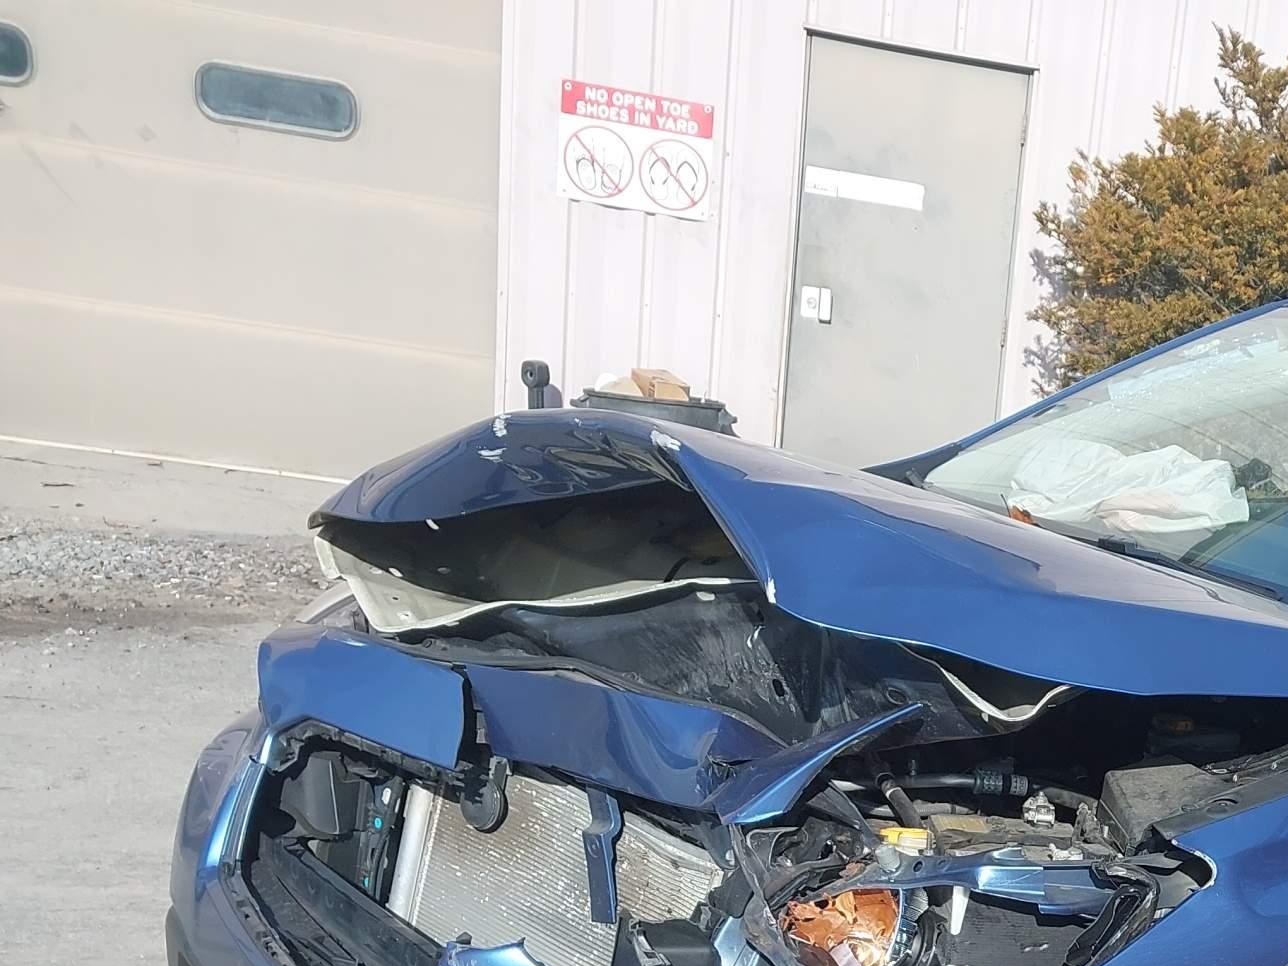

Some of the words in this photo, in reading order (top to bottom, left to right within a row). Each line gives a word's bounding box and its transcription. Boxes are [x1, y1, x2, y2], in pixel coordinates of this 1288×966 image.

[576, 100, 629, 122] SHOES
[634, 110, 651, 126] IN
[656, 114, 699, 135] YARD
[585, 86, 608, 103] NO
[612, 91, 656, 112] OPEN
[661, 101, 690, 119] TOE
